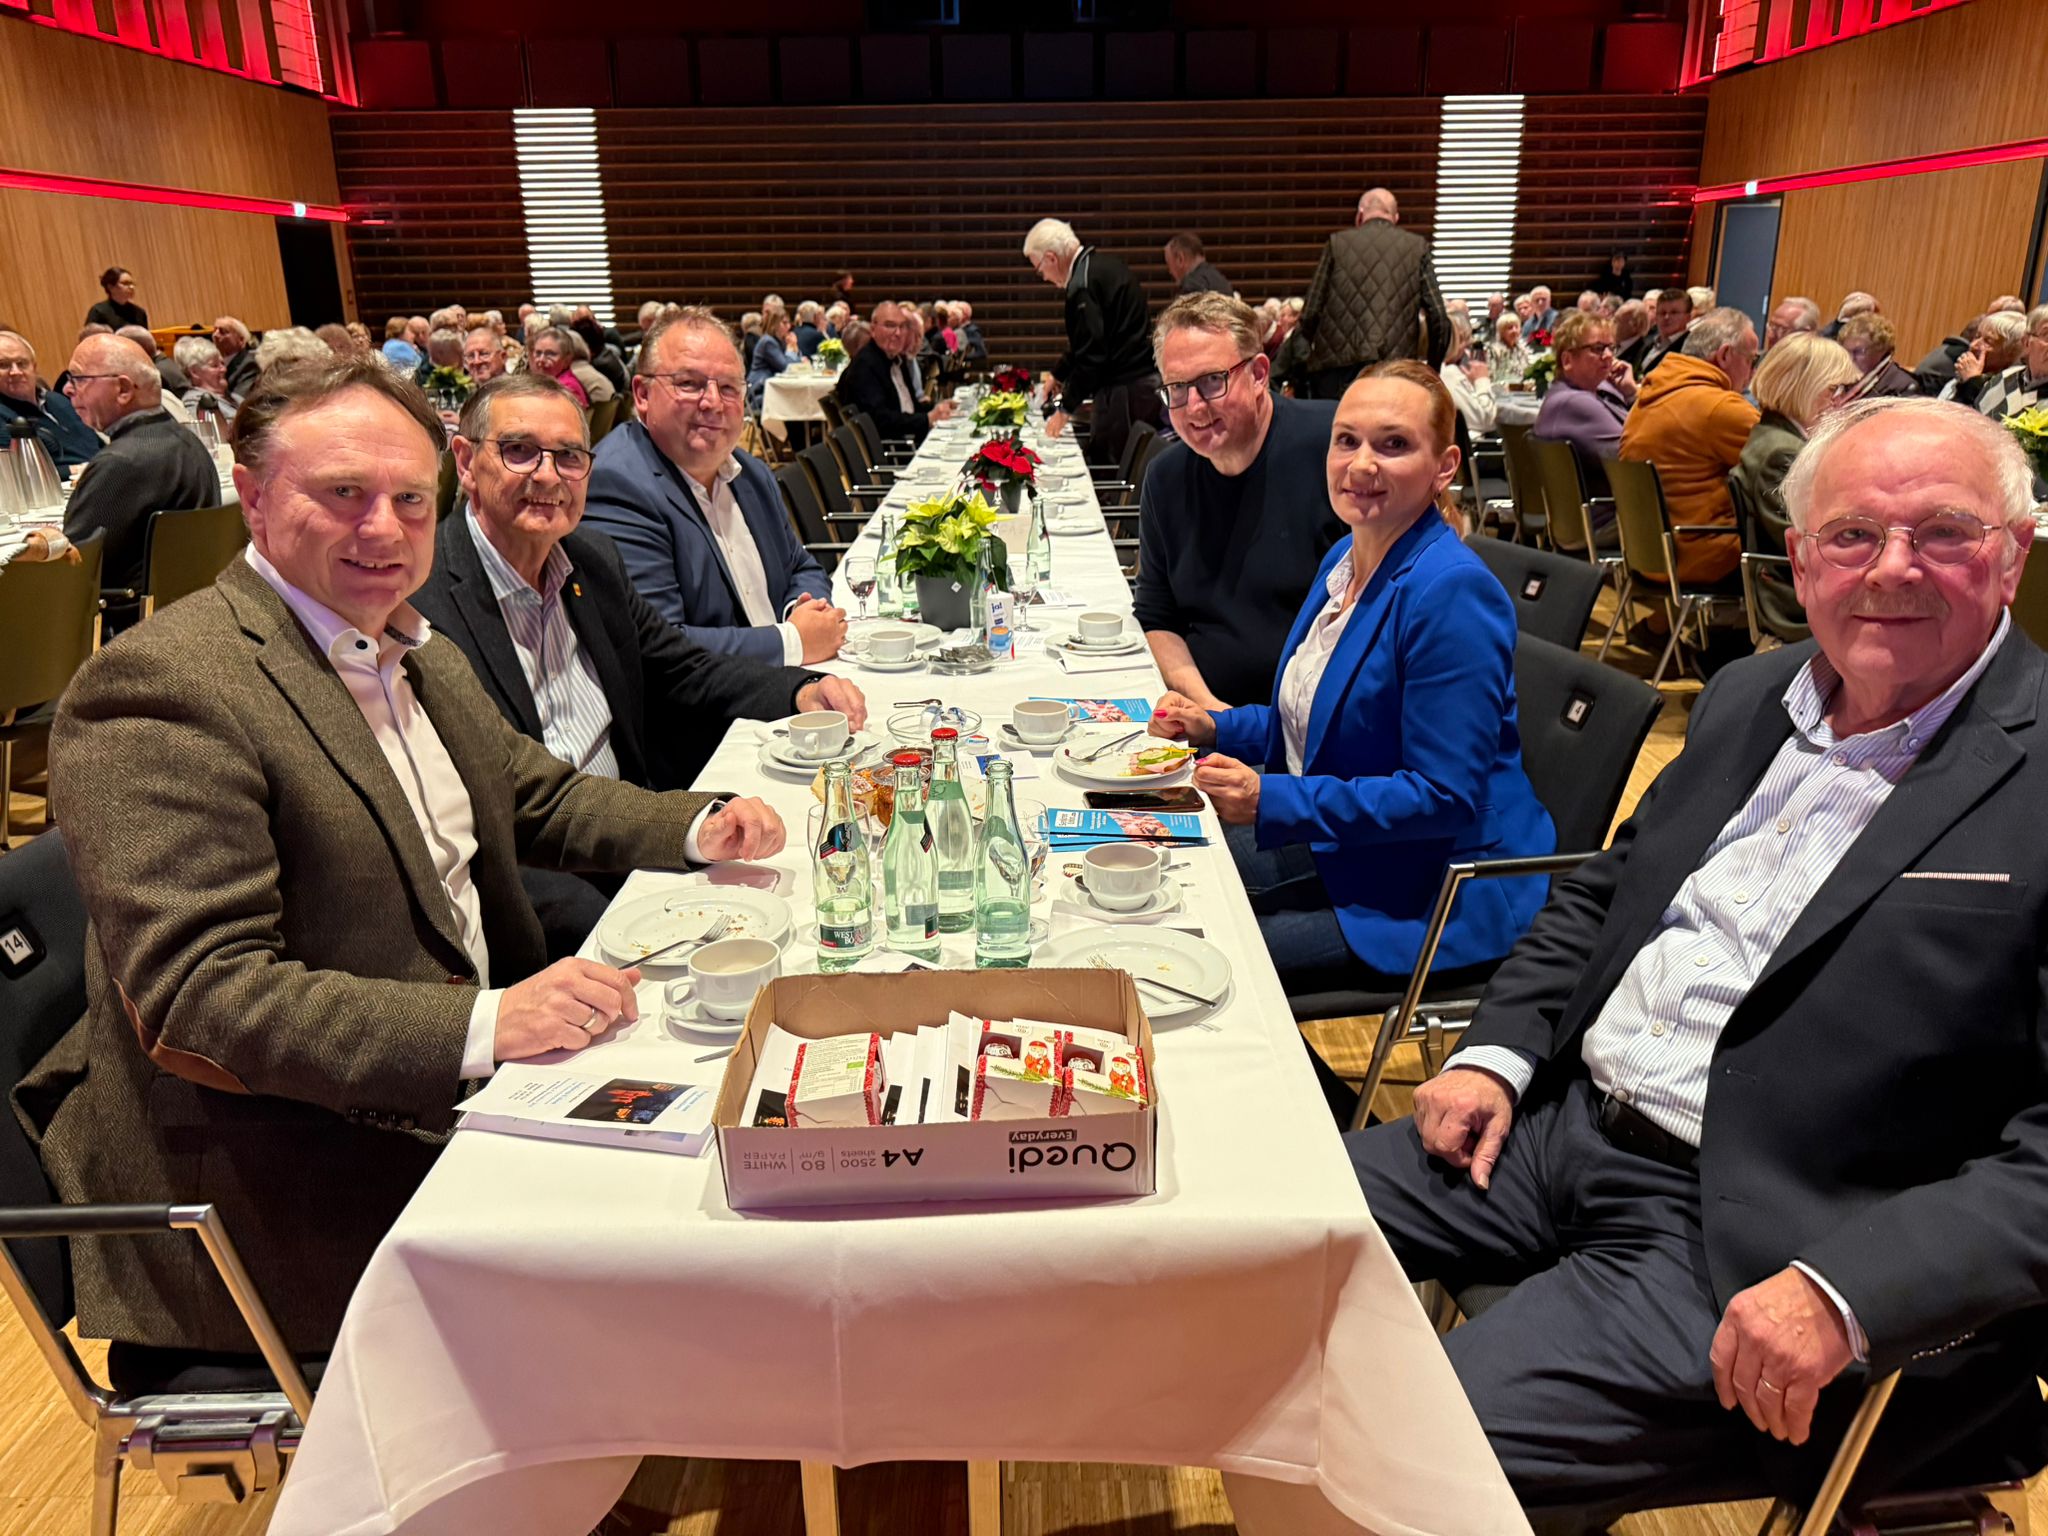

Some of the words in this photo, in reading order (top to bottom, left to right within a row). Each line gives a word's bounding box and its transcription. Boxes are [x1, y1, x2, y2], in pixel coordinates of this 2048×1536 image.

[5, 934, 24, 954] 14
[1011, 1130, 1073, 1142] Everyday
[743, 1151, 786, 1160] PAPER
[840, 1149, 876, 1158] sheets
[881, 1148, 924, 1168] A4
[1009, 1142, 1137, 1173] Quedi
[743, 1160, 787, 1170] WHITE
[801, 1160, 826, 1171] 80
[840, 1158, 877, 1169] 2500
